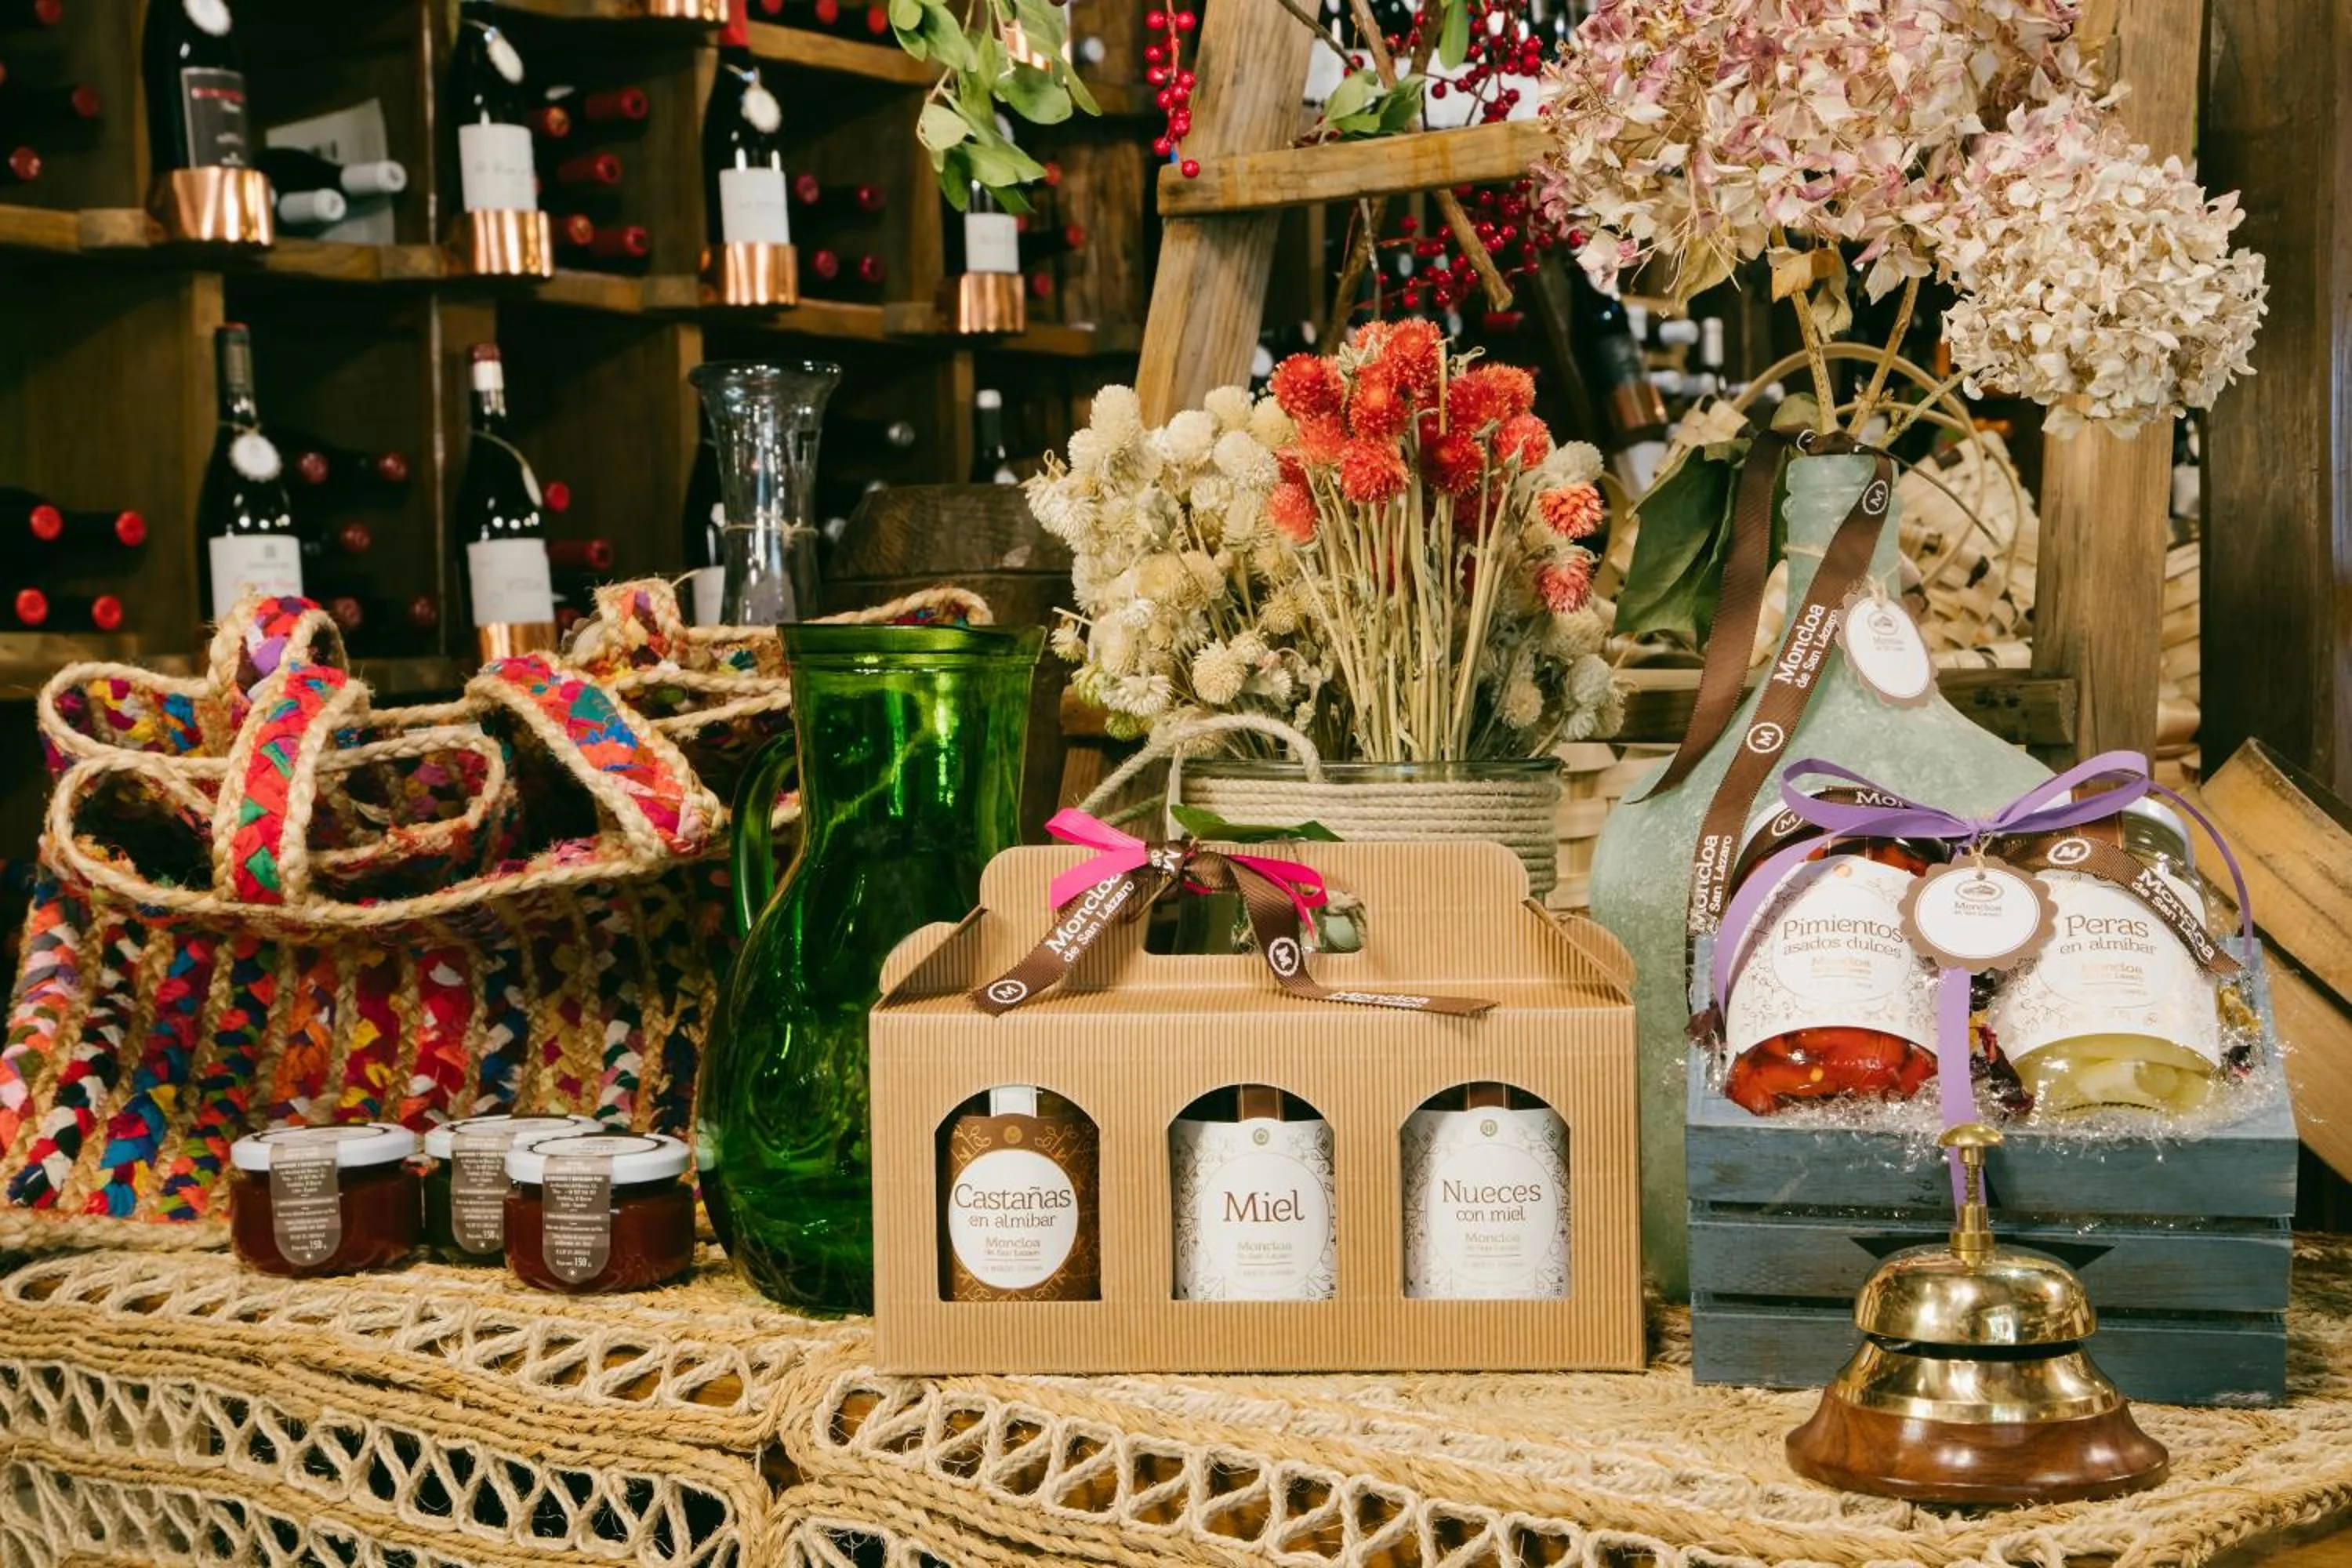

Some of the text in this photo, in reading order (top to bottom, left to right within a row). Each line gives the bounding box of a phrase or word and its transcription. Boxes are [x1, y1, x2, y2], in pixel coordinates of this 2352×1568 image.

[1773, 604, 1825, 684] Moncloa
[1795, 673, 1810, 688] de
[1803, 650, 1822, 671] San
[1709, 885, 1722, 912] San
[2152, 896, 2177, 920] San
[1783, 913, 1904, 943] Pimientos
[2065, 914, 2149, 938] Peras
[1064, 946, 1080, 962] de
[1076, 921, 1100, 945] San
[1783, 936, 1902, 959] asados dulces
[2059, 942, 2082, 954] en
[954, 1183, 1072, 1210] Castañas
[1443, 1178, 1541, 1203] Nueces
[1223, 1189, 1306, 1223] Miel
[1456, 1206, 1526, 1222] con miel
[969, 1216, 989, 1228] en
